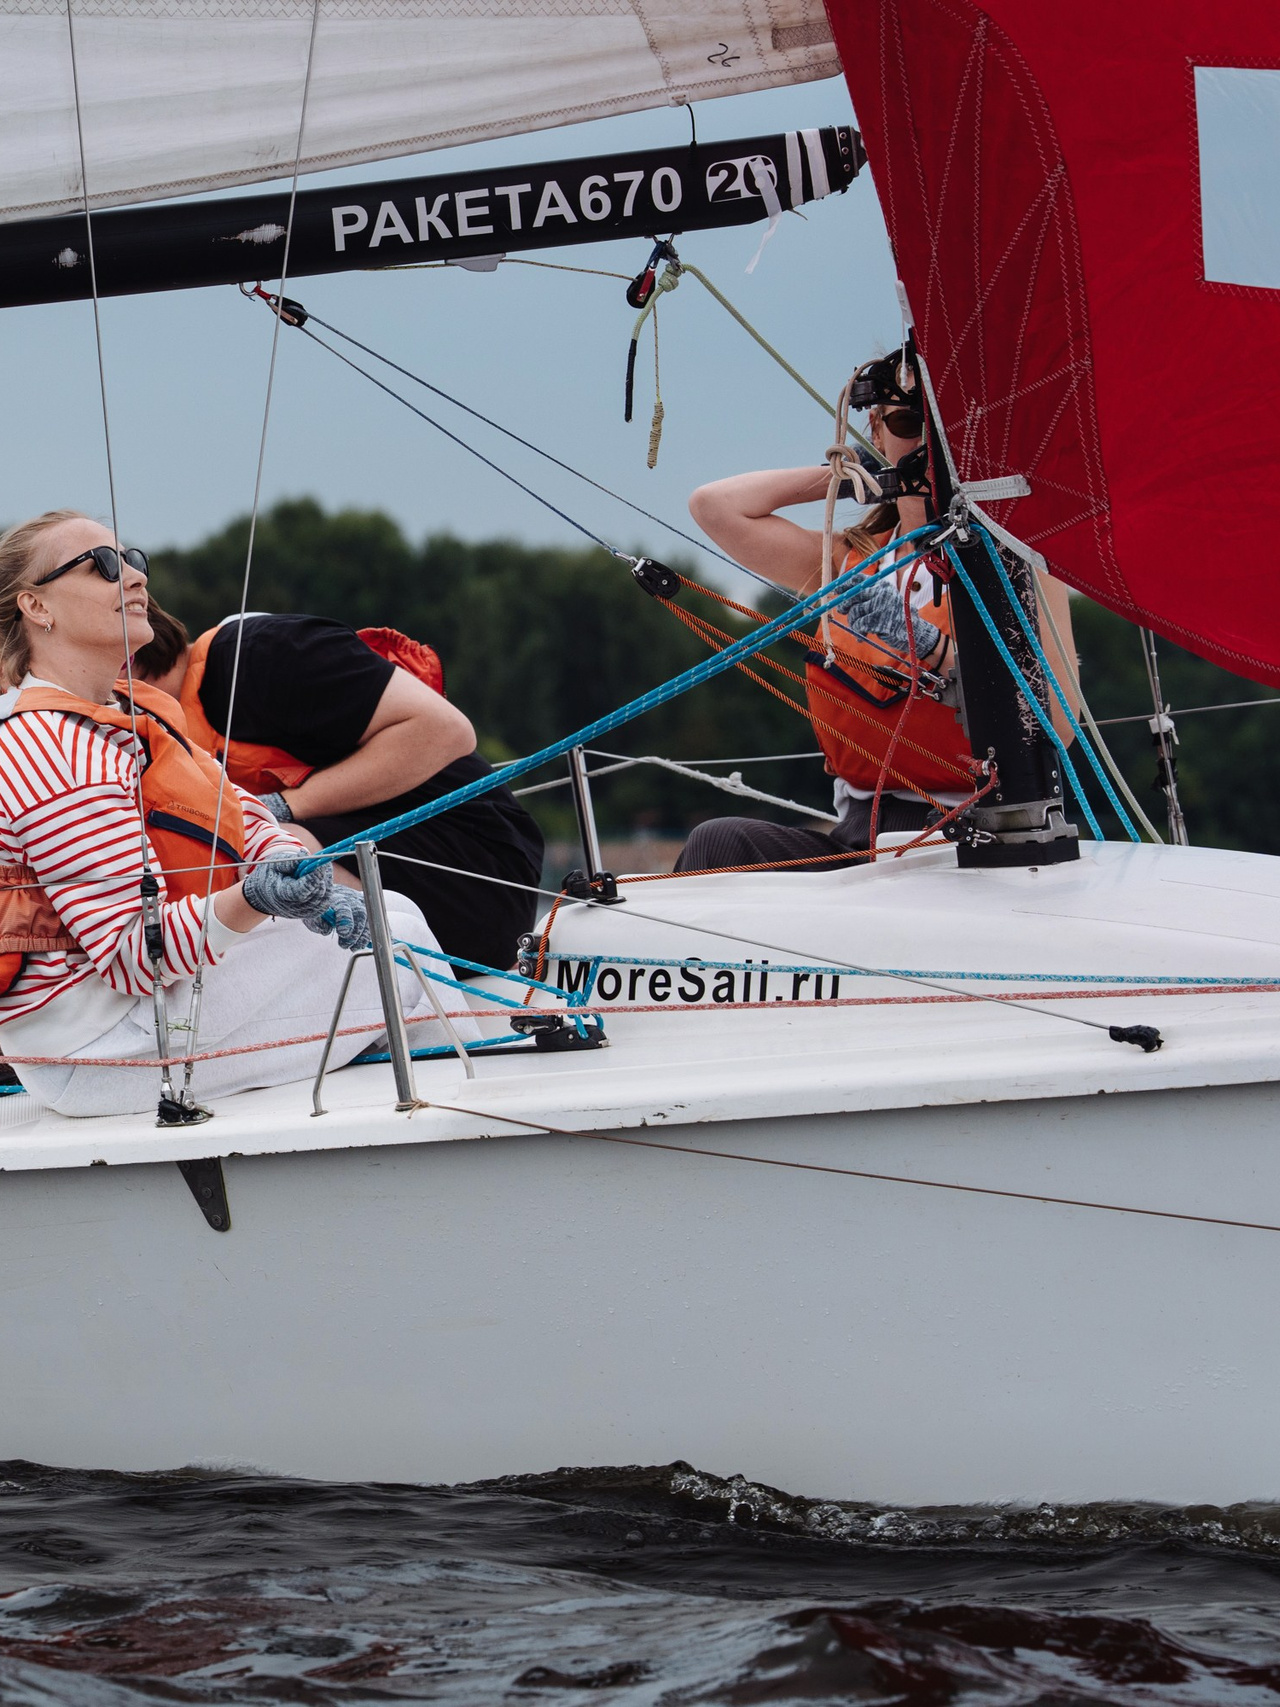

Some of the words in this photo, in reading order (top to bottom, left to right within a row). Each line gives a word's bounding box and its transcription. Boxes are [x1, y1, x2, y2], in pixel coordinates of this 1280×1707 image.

[331, 166, 682, 252] РАКЕТА670
[176, 804, 210, 821] TRIBORD
[556, 957, 840, 1003] MoreSail.ru
